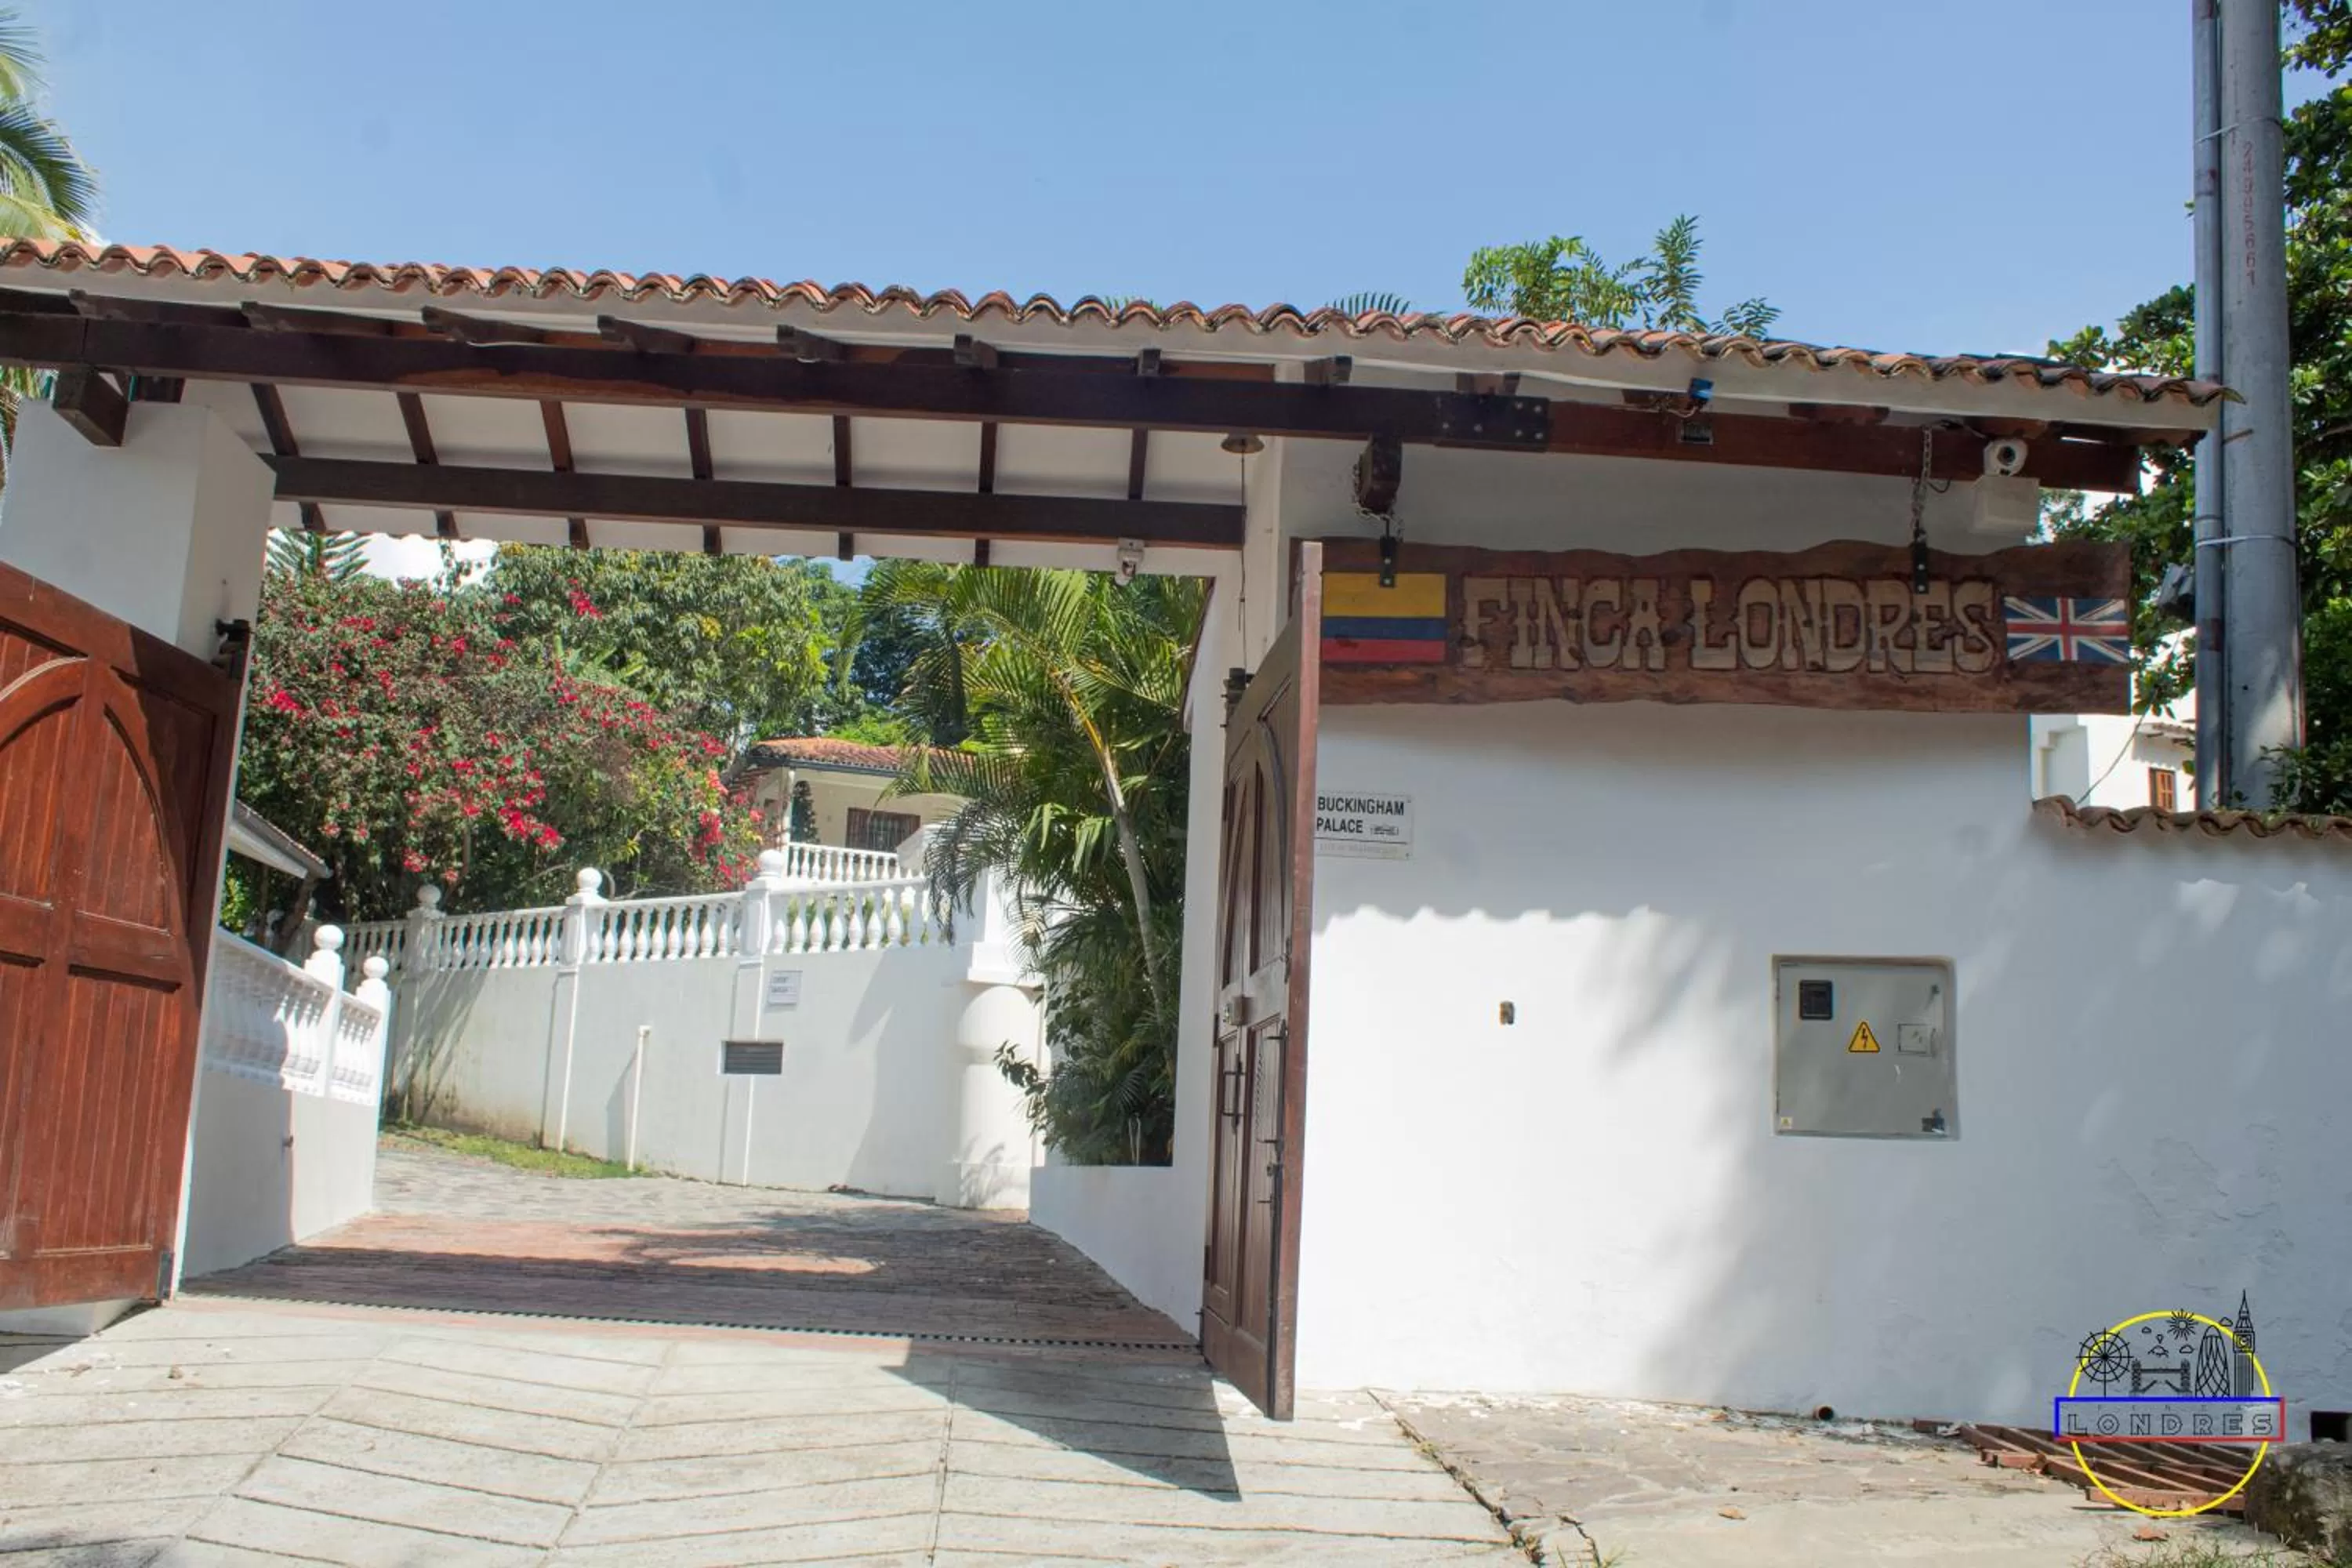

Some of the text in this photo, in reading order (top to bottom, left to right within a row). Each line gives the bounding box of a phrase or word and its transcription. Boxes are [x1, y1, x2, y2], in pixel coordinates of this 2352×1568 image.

[1461, 575, 1998, 673] FINCA LONDRES
[1317, 796, 1405, 816] BUCKINGHAM
[1316, 817, 1364, 834] PALACE
